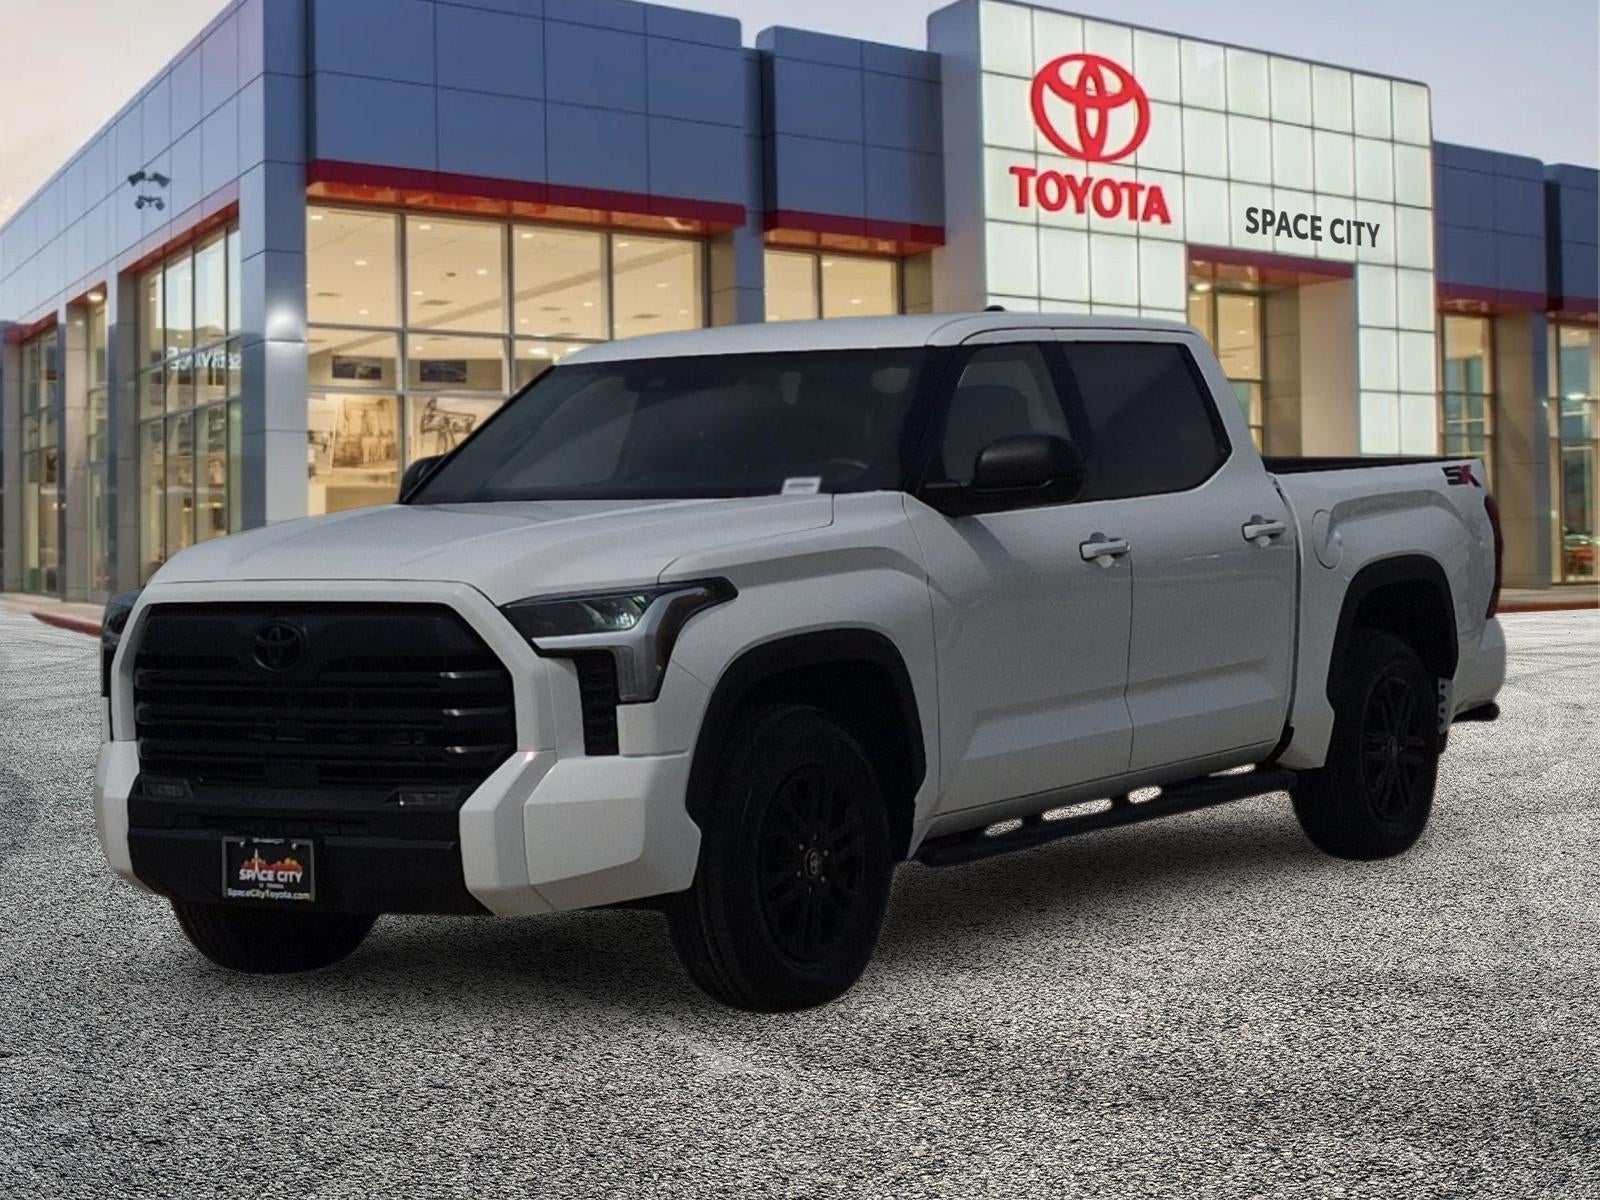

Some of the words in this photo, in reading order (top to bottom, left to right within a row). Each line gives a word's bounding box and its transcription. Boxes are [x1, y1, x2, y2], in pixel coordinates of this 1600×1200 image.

[1009, 166, 1171, 224] TOYOTA
[1245, 207, 1323, 242] SPACE
[1329, 218, 1380, 248] CITY
[239, 868, 275, 882] SPACE
[276, 871, 303, 884] CITY
[227, 888, 310, 900] SpaceCityToyota.com
